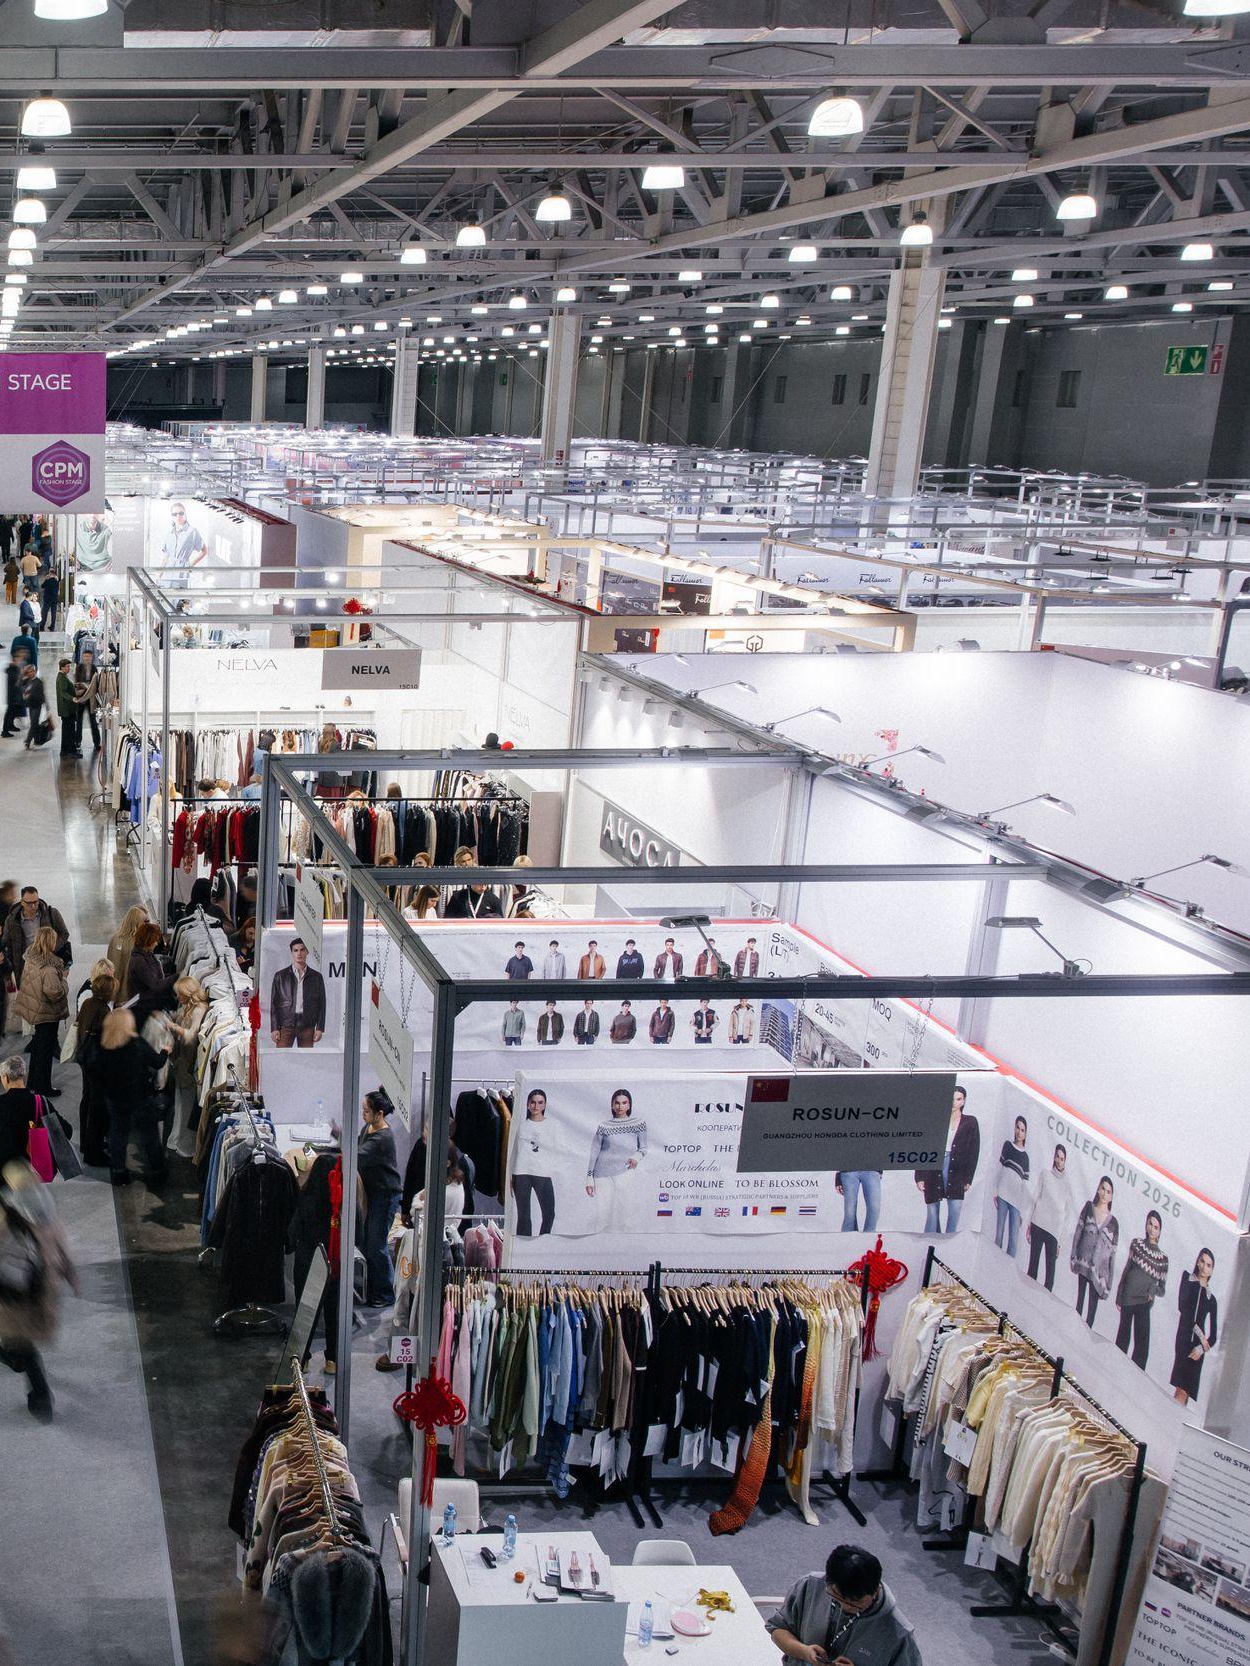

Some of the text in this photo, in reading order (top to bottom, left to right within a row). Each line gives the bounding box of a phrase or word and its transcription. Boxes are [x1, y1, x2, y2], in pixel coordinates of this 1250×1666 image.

[7, 374, 72, 391] STAGE
[39, 462, 84, 478] CPM
[217, 658, 278, 671] NELVA
[351, 665, 391, 675] NELVA
[771, 932, 799, 955] Sample
[329, 961, 378, 978] MN
[871, 999, 892, 1022] MOQ
[865, 1041, 880, 1060] 300
[792, 1106, 900, 1121] ROSUN-CN
[762, 1132, 813, 1140] GUANGZHOU
[849, 1131, 890, 1139] CLOTHING
[891, 1130, 924, 1138] LIMITED
[663, 1144, 734, 1153] TOPTOP THE
[888, 1151, 938, 1163] 15C02
[1046, 1115, 1182, 1218] COLLECTION 2026
[659, 1179, 725, 1189] LOOK ONLINE
[735, 1179, 819, 1188] TO BE BLOSSOM
[396, 1355, 414, 1363] C02
[1213, 1450, 1233, 1463] OUR
[1141, 1612, 1177, 1635] TOPTOP
[1176, 1601, 1246, 1641] PARTNER BRANDS
[1136, 1630, 1158, 1648] THE
